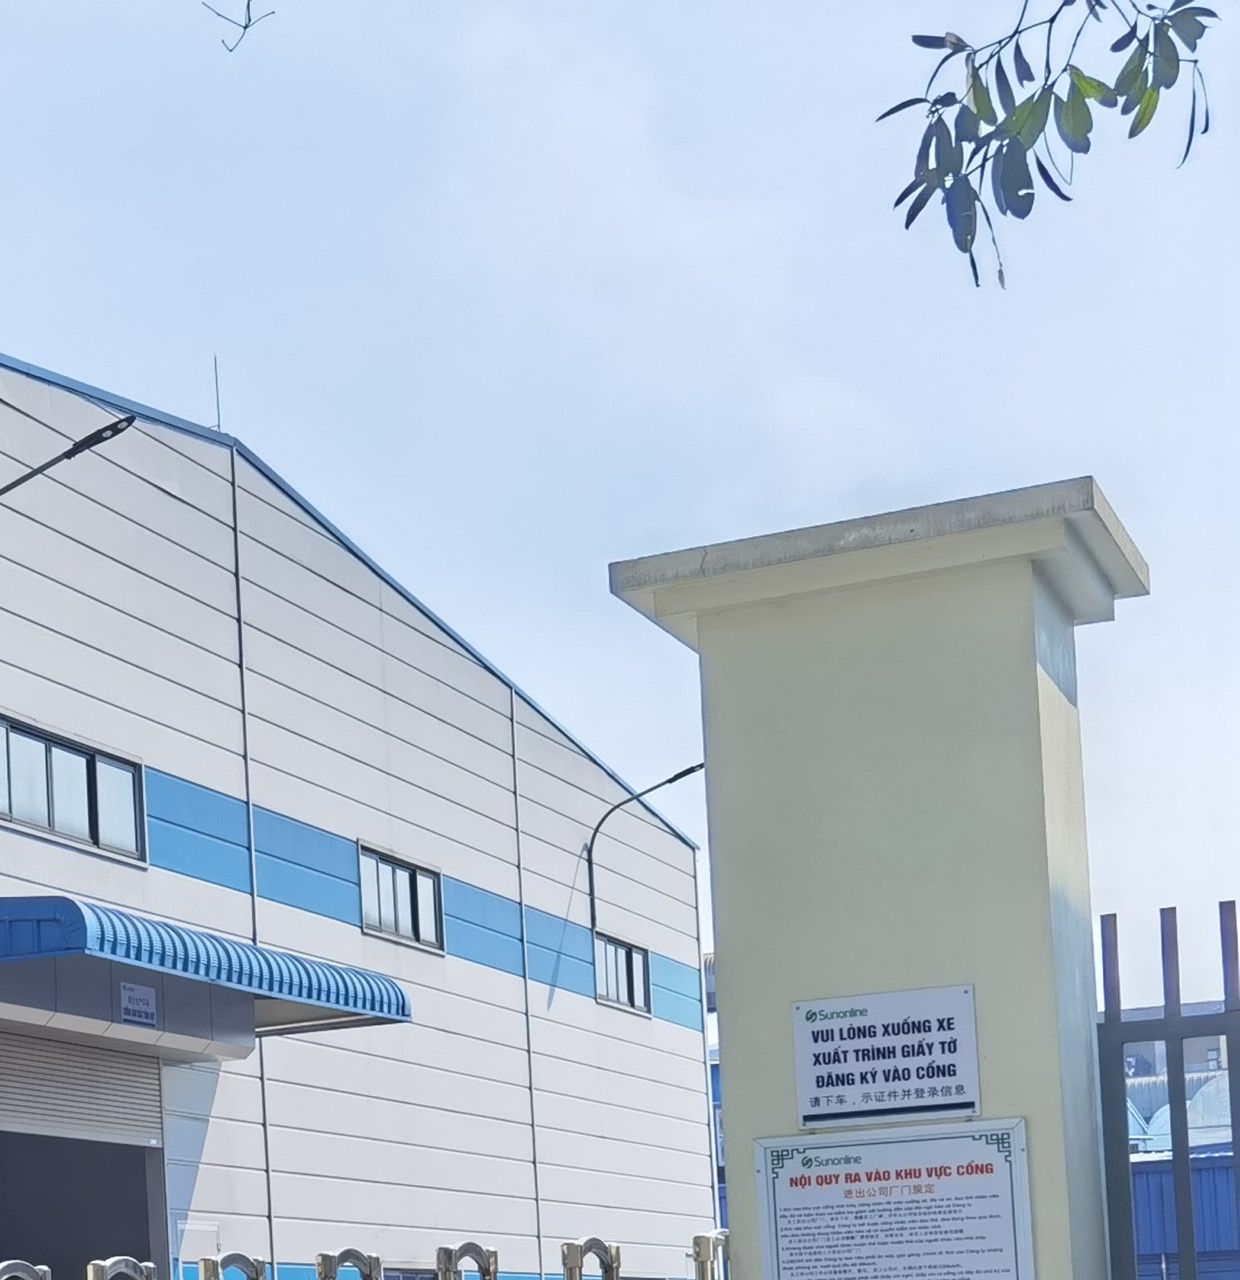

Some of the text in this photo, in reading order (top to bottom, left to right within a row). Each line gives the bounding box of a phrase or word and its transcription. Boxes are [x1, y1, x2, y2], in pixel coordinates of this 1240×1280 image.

[818, 1008, 868, 1021] Sunonline
[811, 1017, 955, 1043] VUI LÒNG XUỐNG XE
[812, 1037, 958, 1066] XUẤT TRÌNH GIẤY TỜ
[816, 1072, 855, 1088] ĐĂNG
[860, 1067, 878, 1084] KÝ
[883, 1066, 911, 1082] VÀO
[814, 1155, 862, 1167] Sunonline
[789, 1172, 811, 1188] NỘI
[816, 1174, 840, 1186] QUY
[845, 1172, 861, 1184] RA
[866, 1169, 890, 1182] VÀO
[895, 1168, 922, 1180] KHU
[926, 1165, 952, 1180] VỰC
